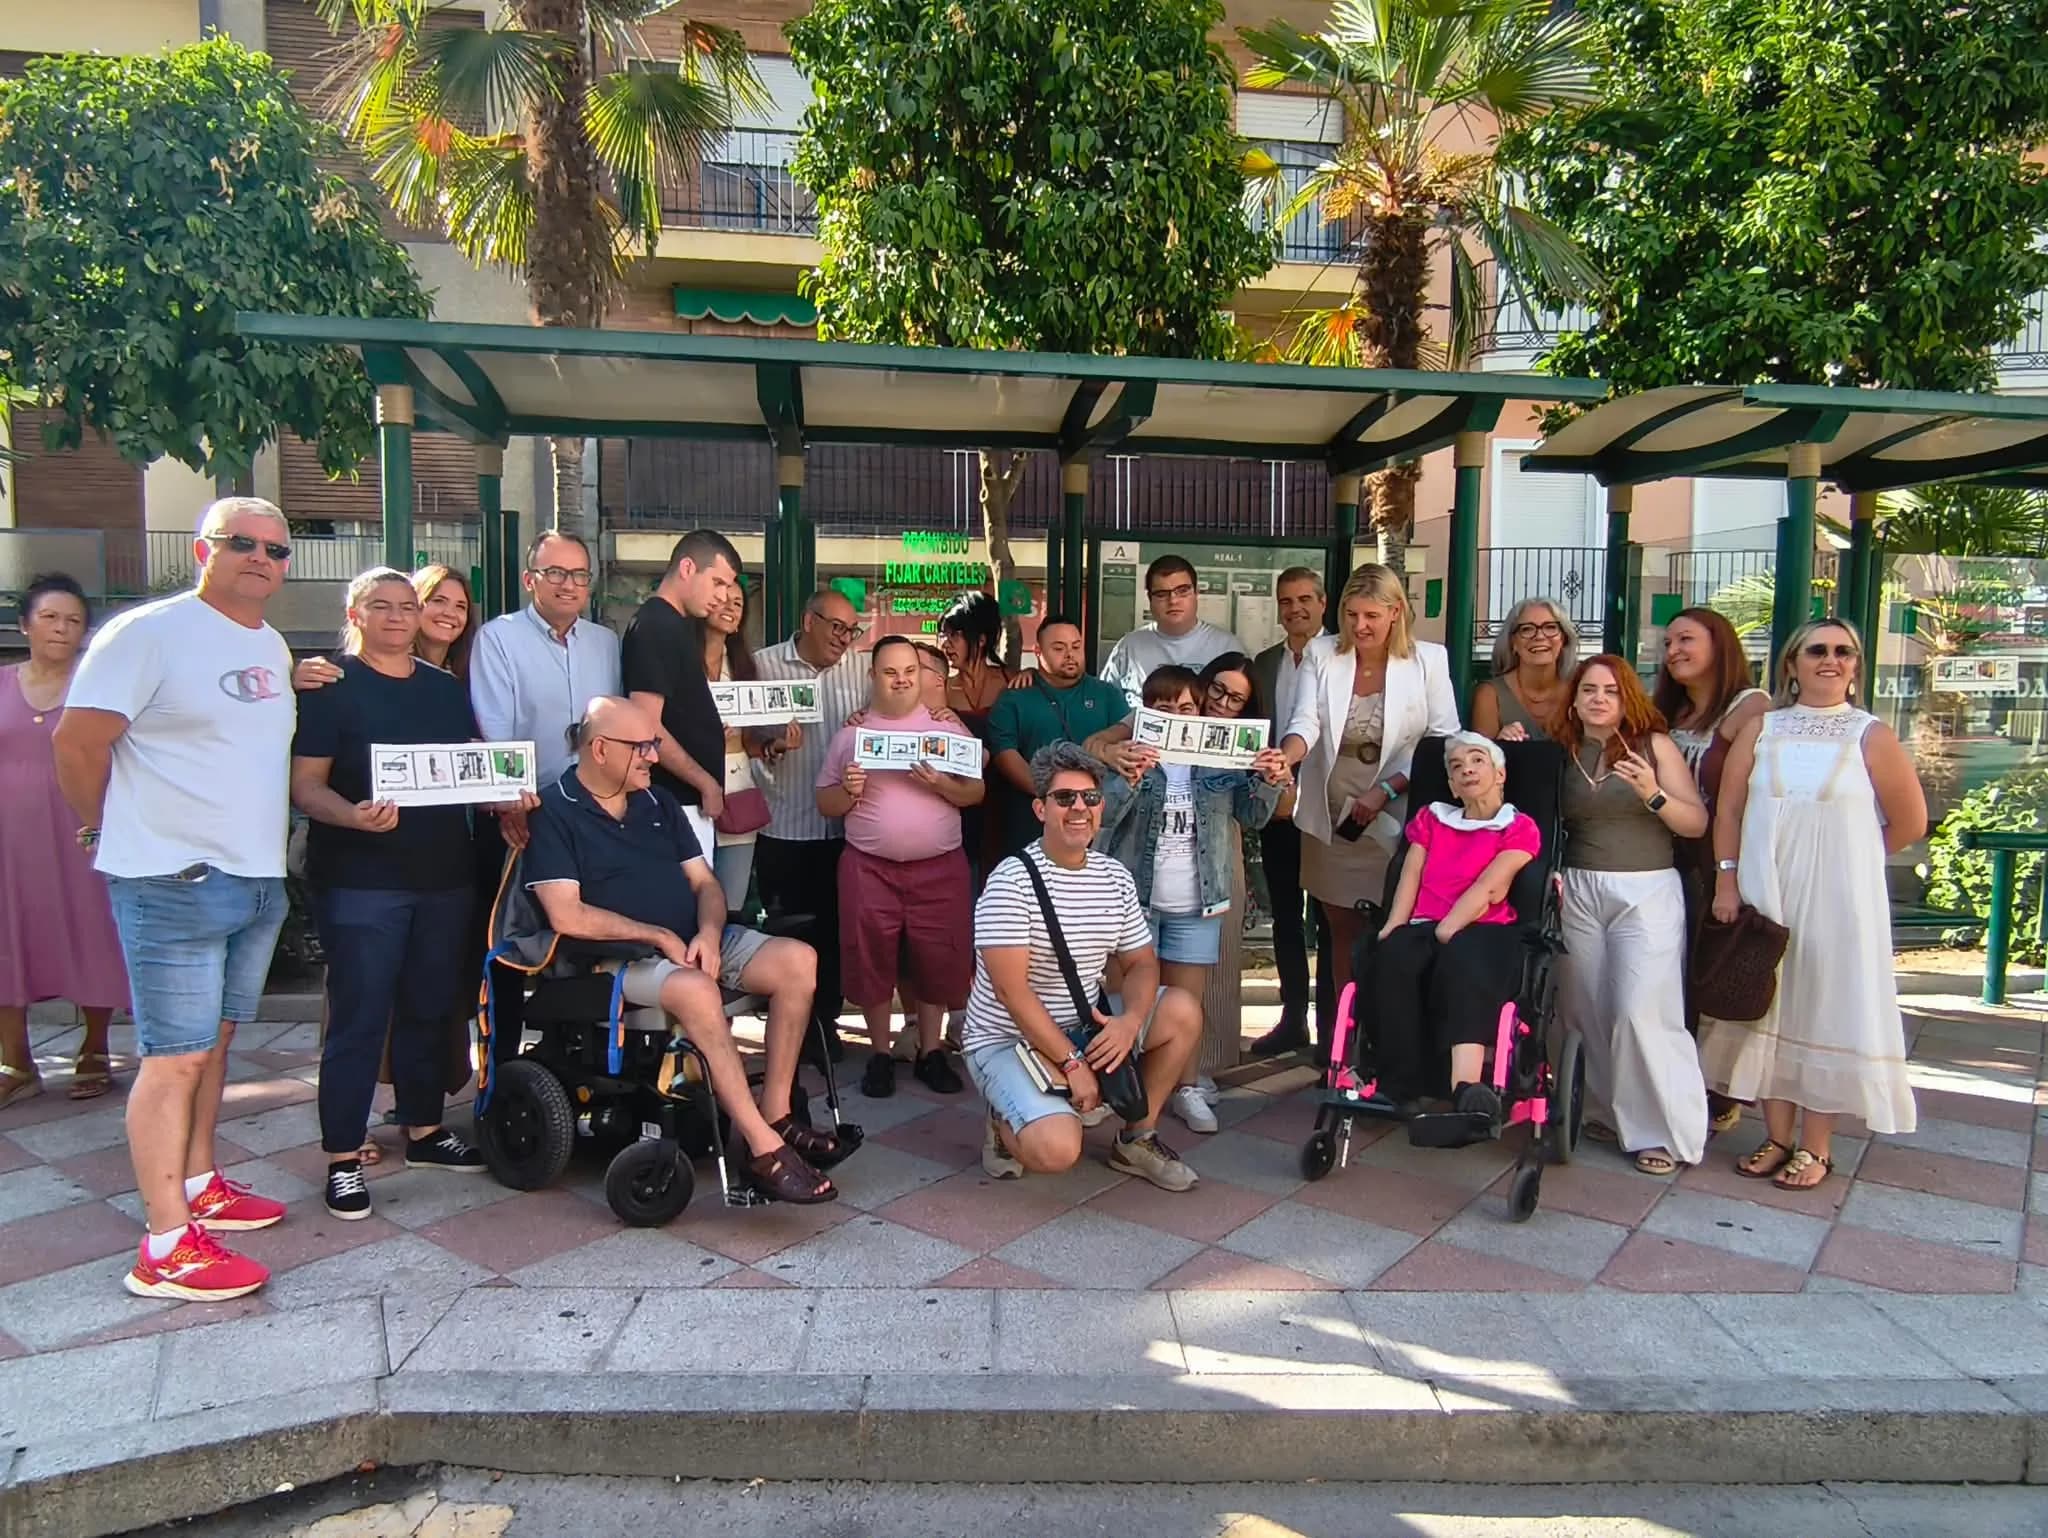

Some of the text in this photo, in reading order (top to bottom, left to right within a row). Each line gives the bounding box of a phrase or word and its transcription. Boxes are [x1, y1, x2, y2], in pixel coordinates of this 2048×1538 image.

[902, 531, 969, 554] PROHIBIDO
[885, 559, 987, 586] FIJAR CARTELES
